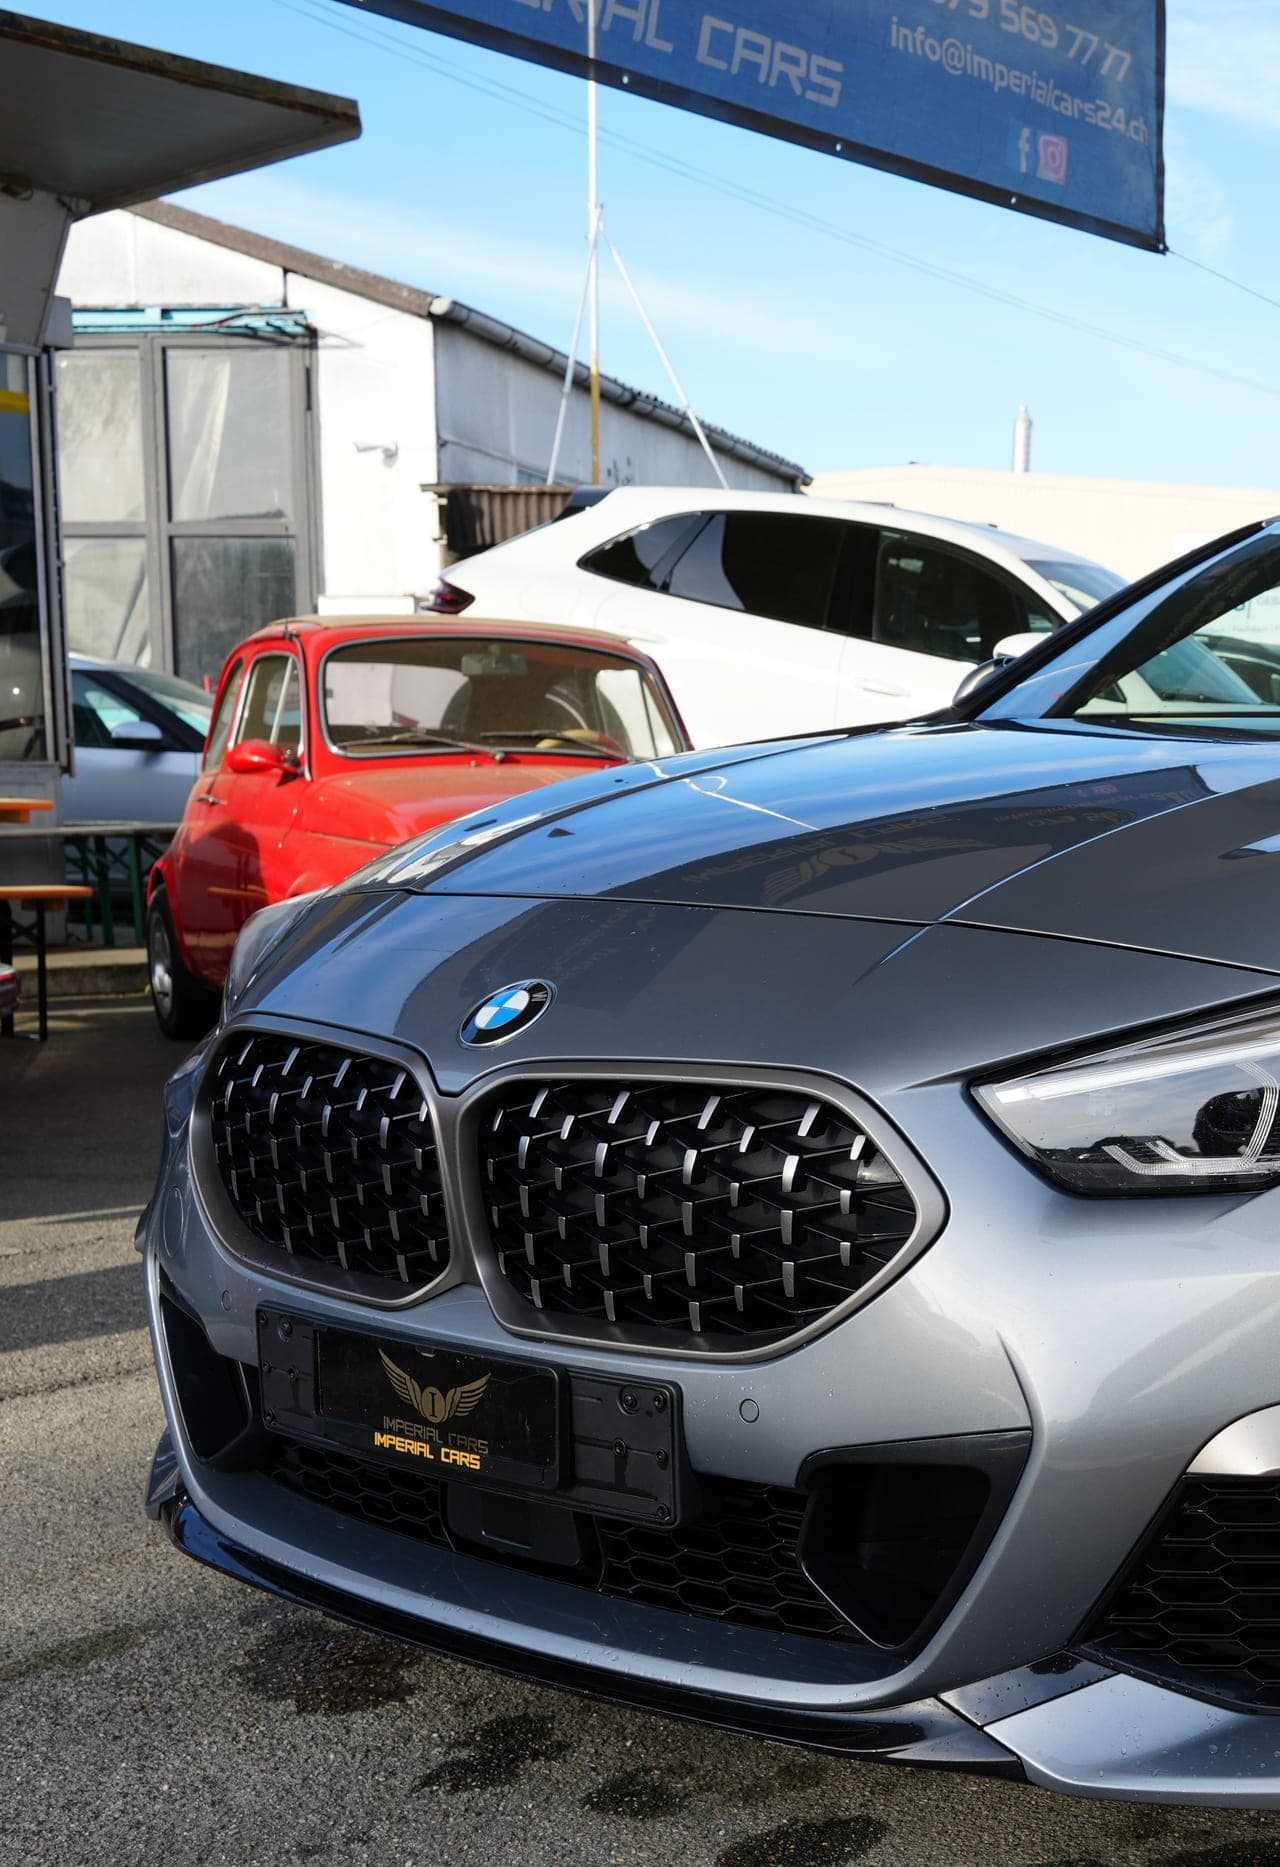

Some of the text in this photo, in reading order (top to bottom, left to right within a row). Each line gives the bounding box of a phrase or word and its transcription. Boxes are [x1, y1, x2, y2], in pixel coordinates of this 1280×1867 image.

[1001, 0, 1059, 49] 569
[696, 15, 844, 107] CARS
[890, 16, 1149, 145] info@imperialcars24.ch
[374, 1431, 481, 1470] IMPERIAL CARS
[383, 1415, 489, 1456] IMPERIAL CARS
